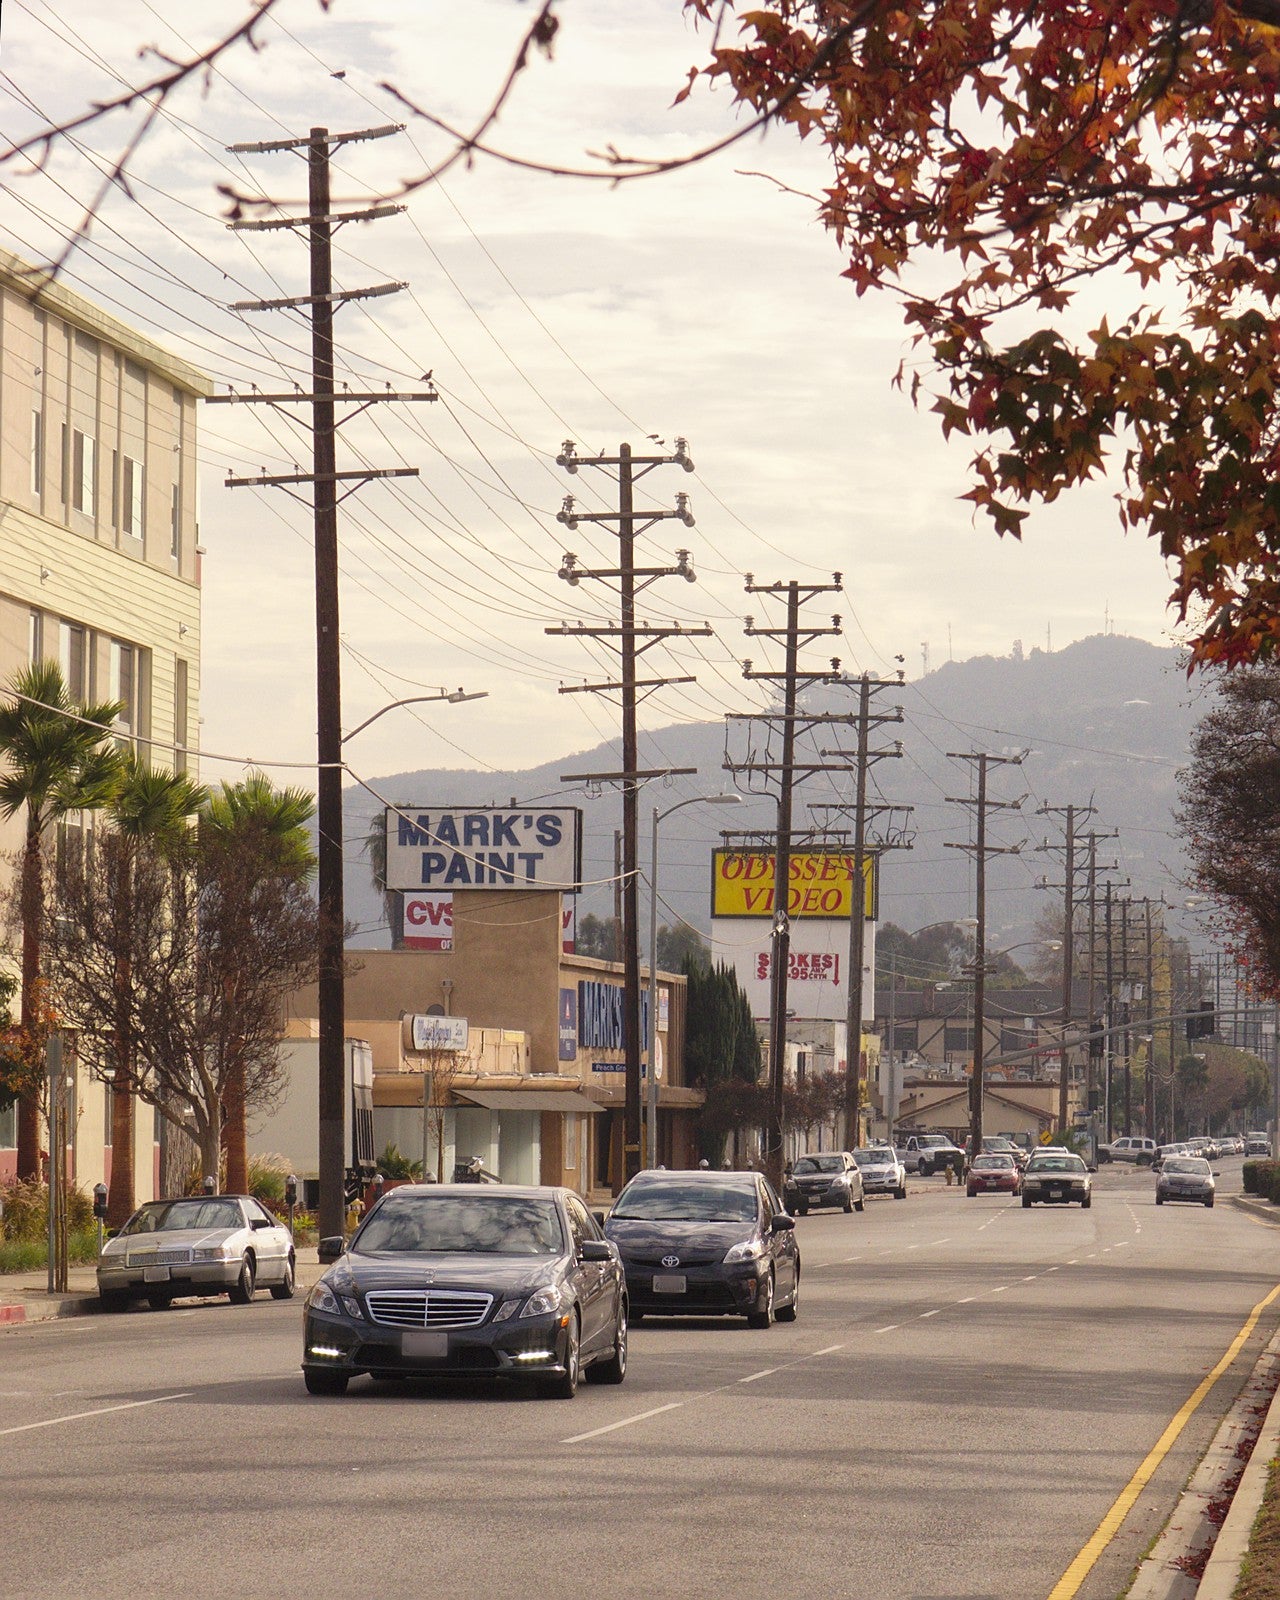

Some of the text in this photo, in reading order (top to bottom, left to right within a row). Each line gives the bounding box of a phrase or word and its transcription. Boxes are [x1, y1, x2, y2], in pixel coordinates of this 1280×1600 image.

[398, 814, 562, 847] MARK'S
[421, 852, 544, 884] PAINT
[742, 887, 843, 912] VIDEO
[758, 953, 833, 968] SOKES
